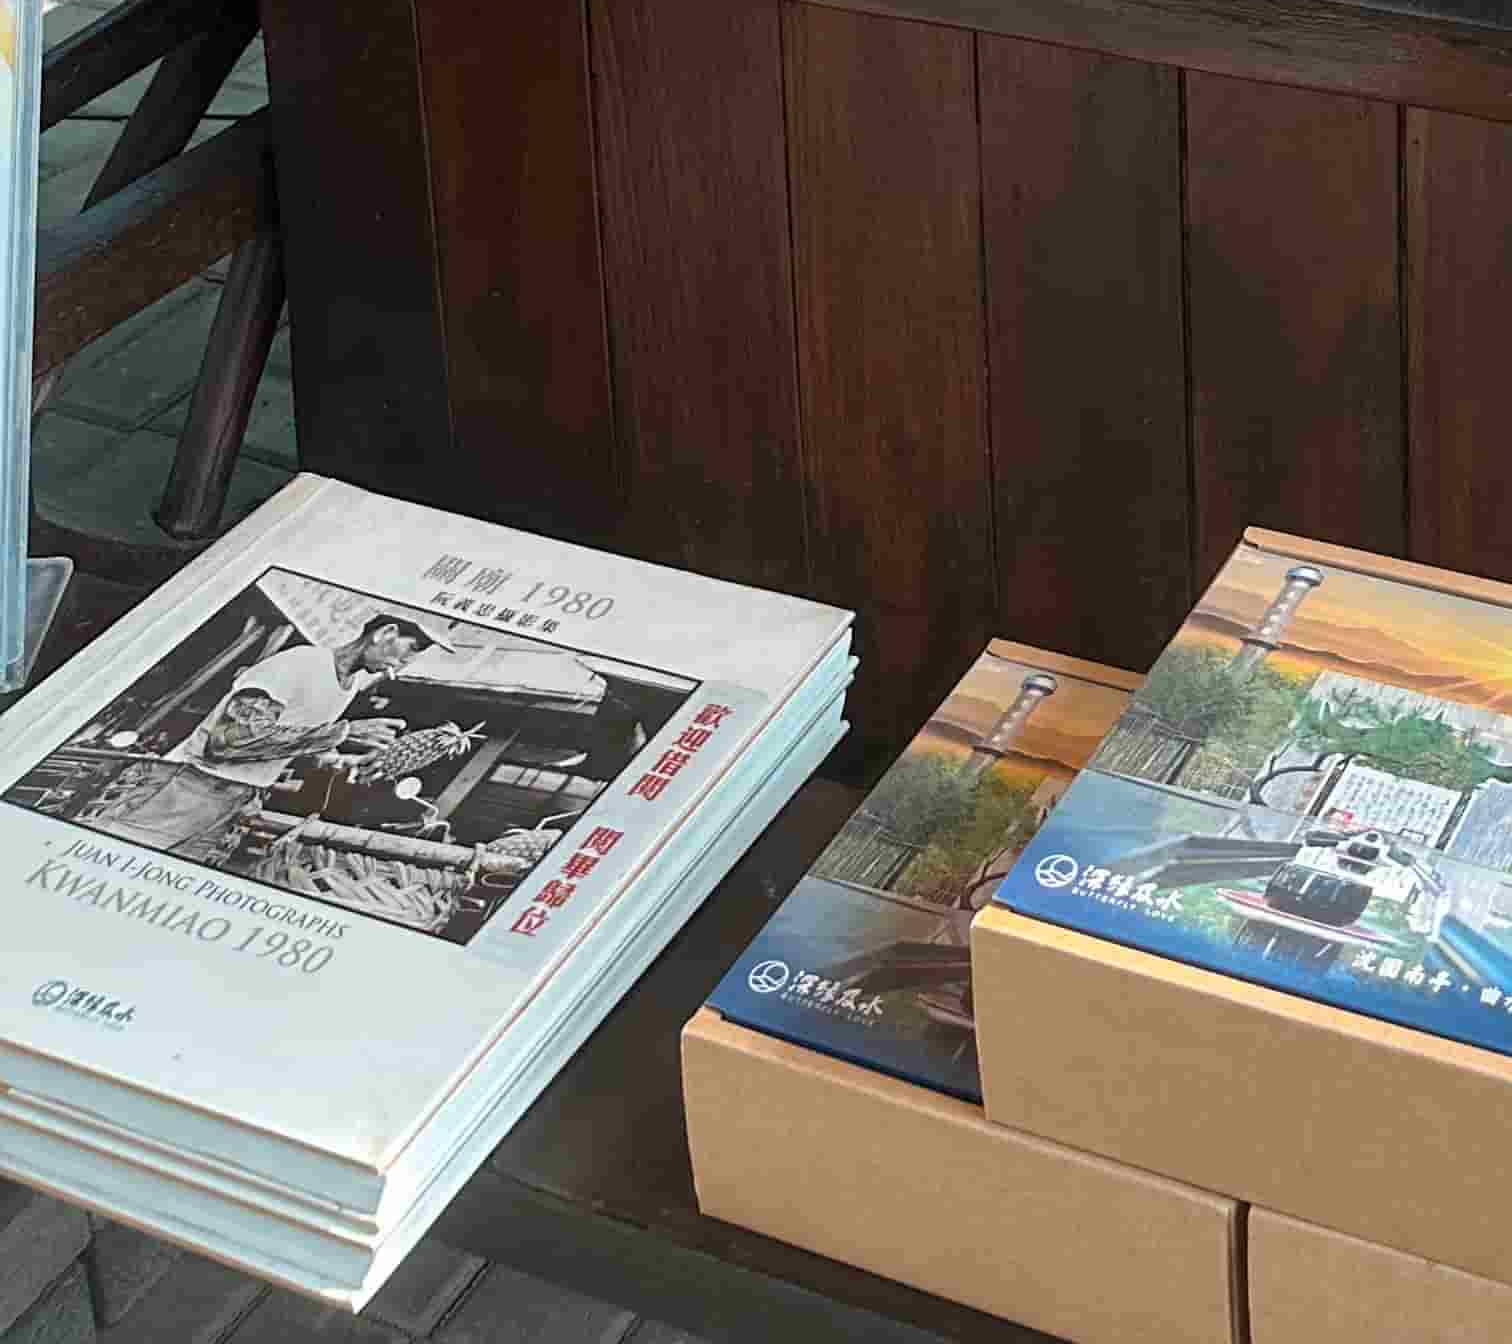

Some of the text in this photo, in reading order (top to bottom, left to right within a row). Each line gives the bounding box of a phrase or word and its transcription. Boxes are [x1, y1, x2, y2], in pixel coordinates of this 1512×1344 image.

[520, 581, 615, 620] 1980
[627, 702, 736, 801] 歡迎借閱
[24, 859, 334, 975] KWANMIAO 1980
[64, 839, 118, 868] JUAN
[192, 879, 351, 939] PHOTOGRAPHS
[511, 826, 625, 937] 閱畢歸位
